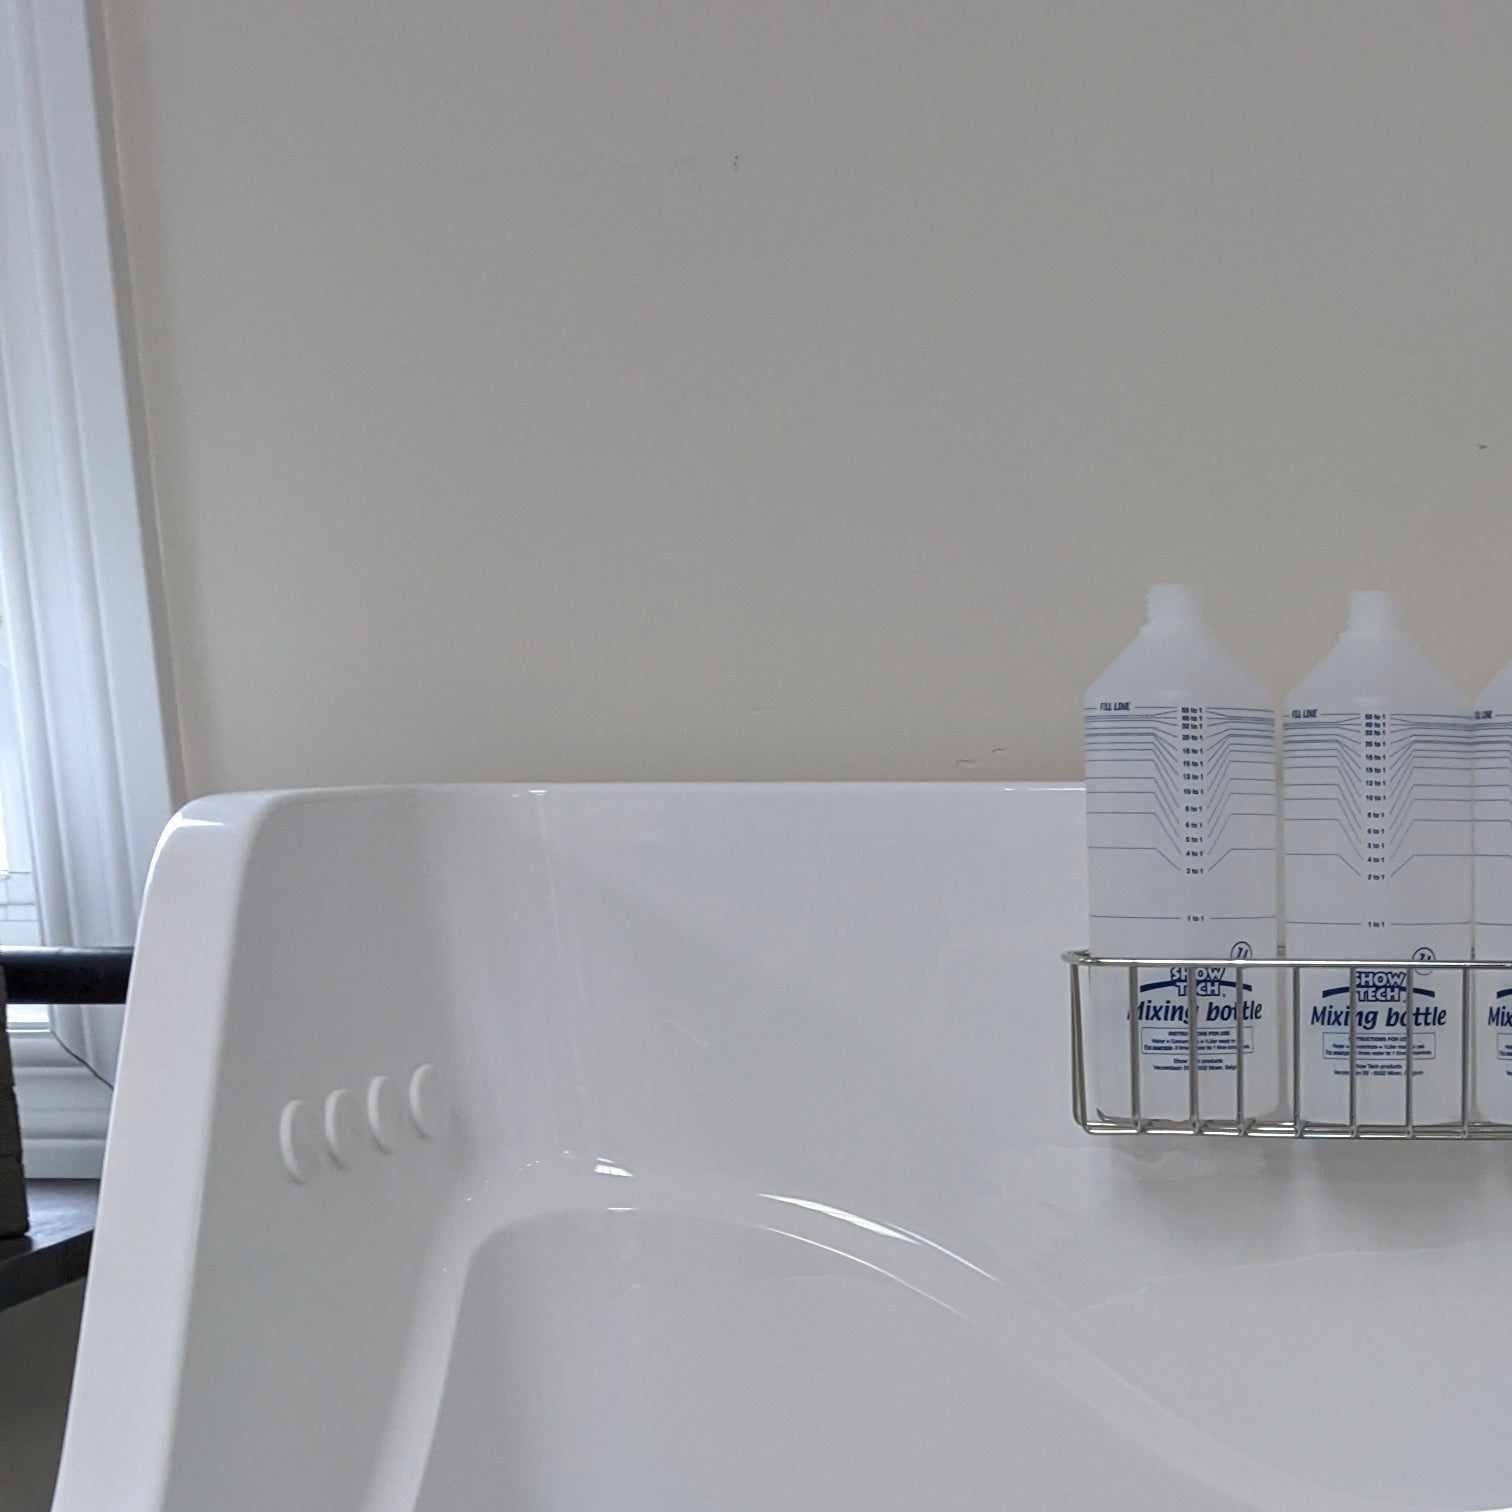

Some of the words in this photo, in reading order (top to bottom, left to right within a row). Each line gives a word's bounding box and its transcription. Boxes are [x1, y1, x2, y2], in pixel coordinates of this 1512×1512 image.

[1177, 981, 1220, 996] TCH
[1357, 987, 1401, 1002] TECH
[1310, 1005, 1379, 1030] Mixing
